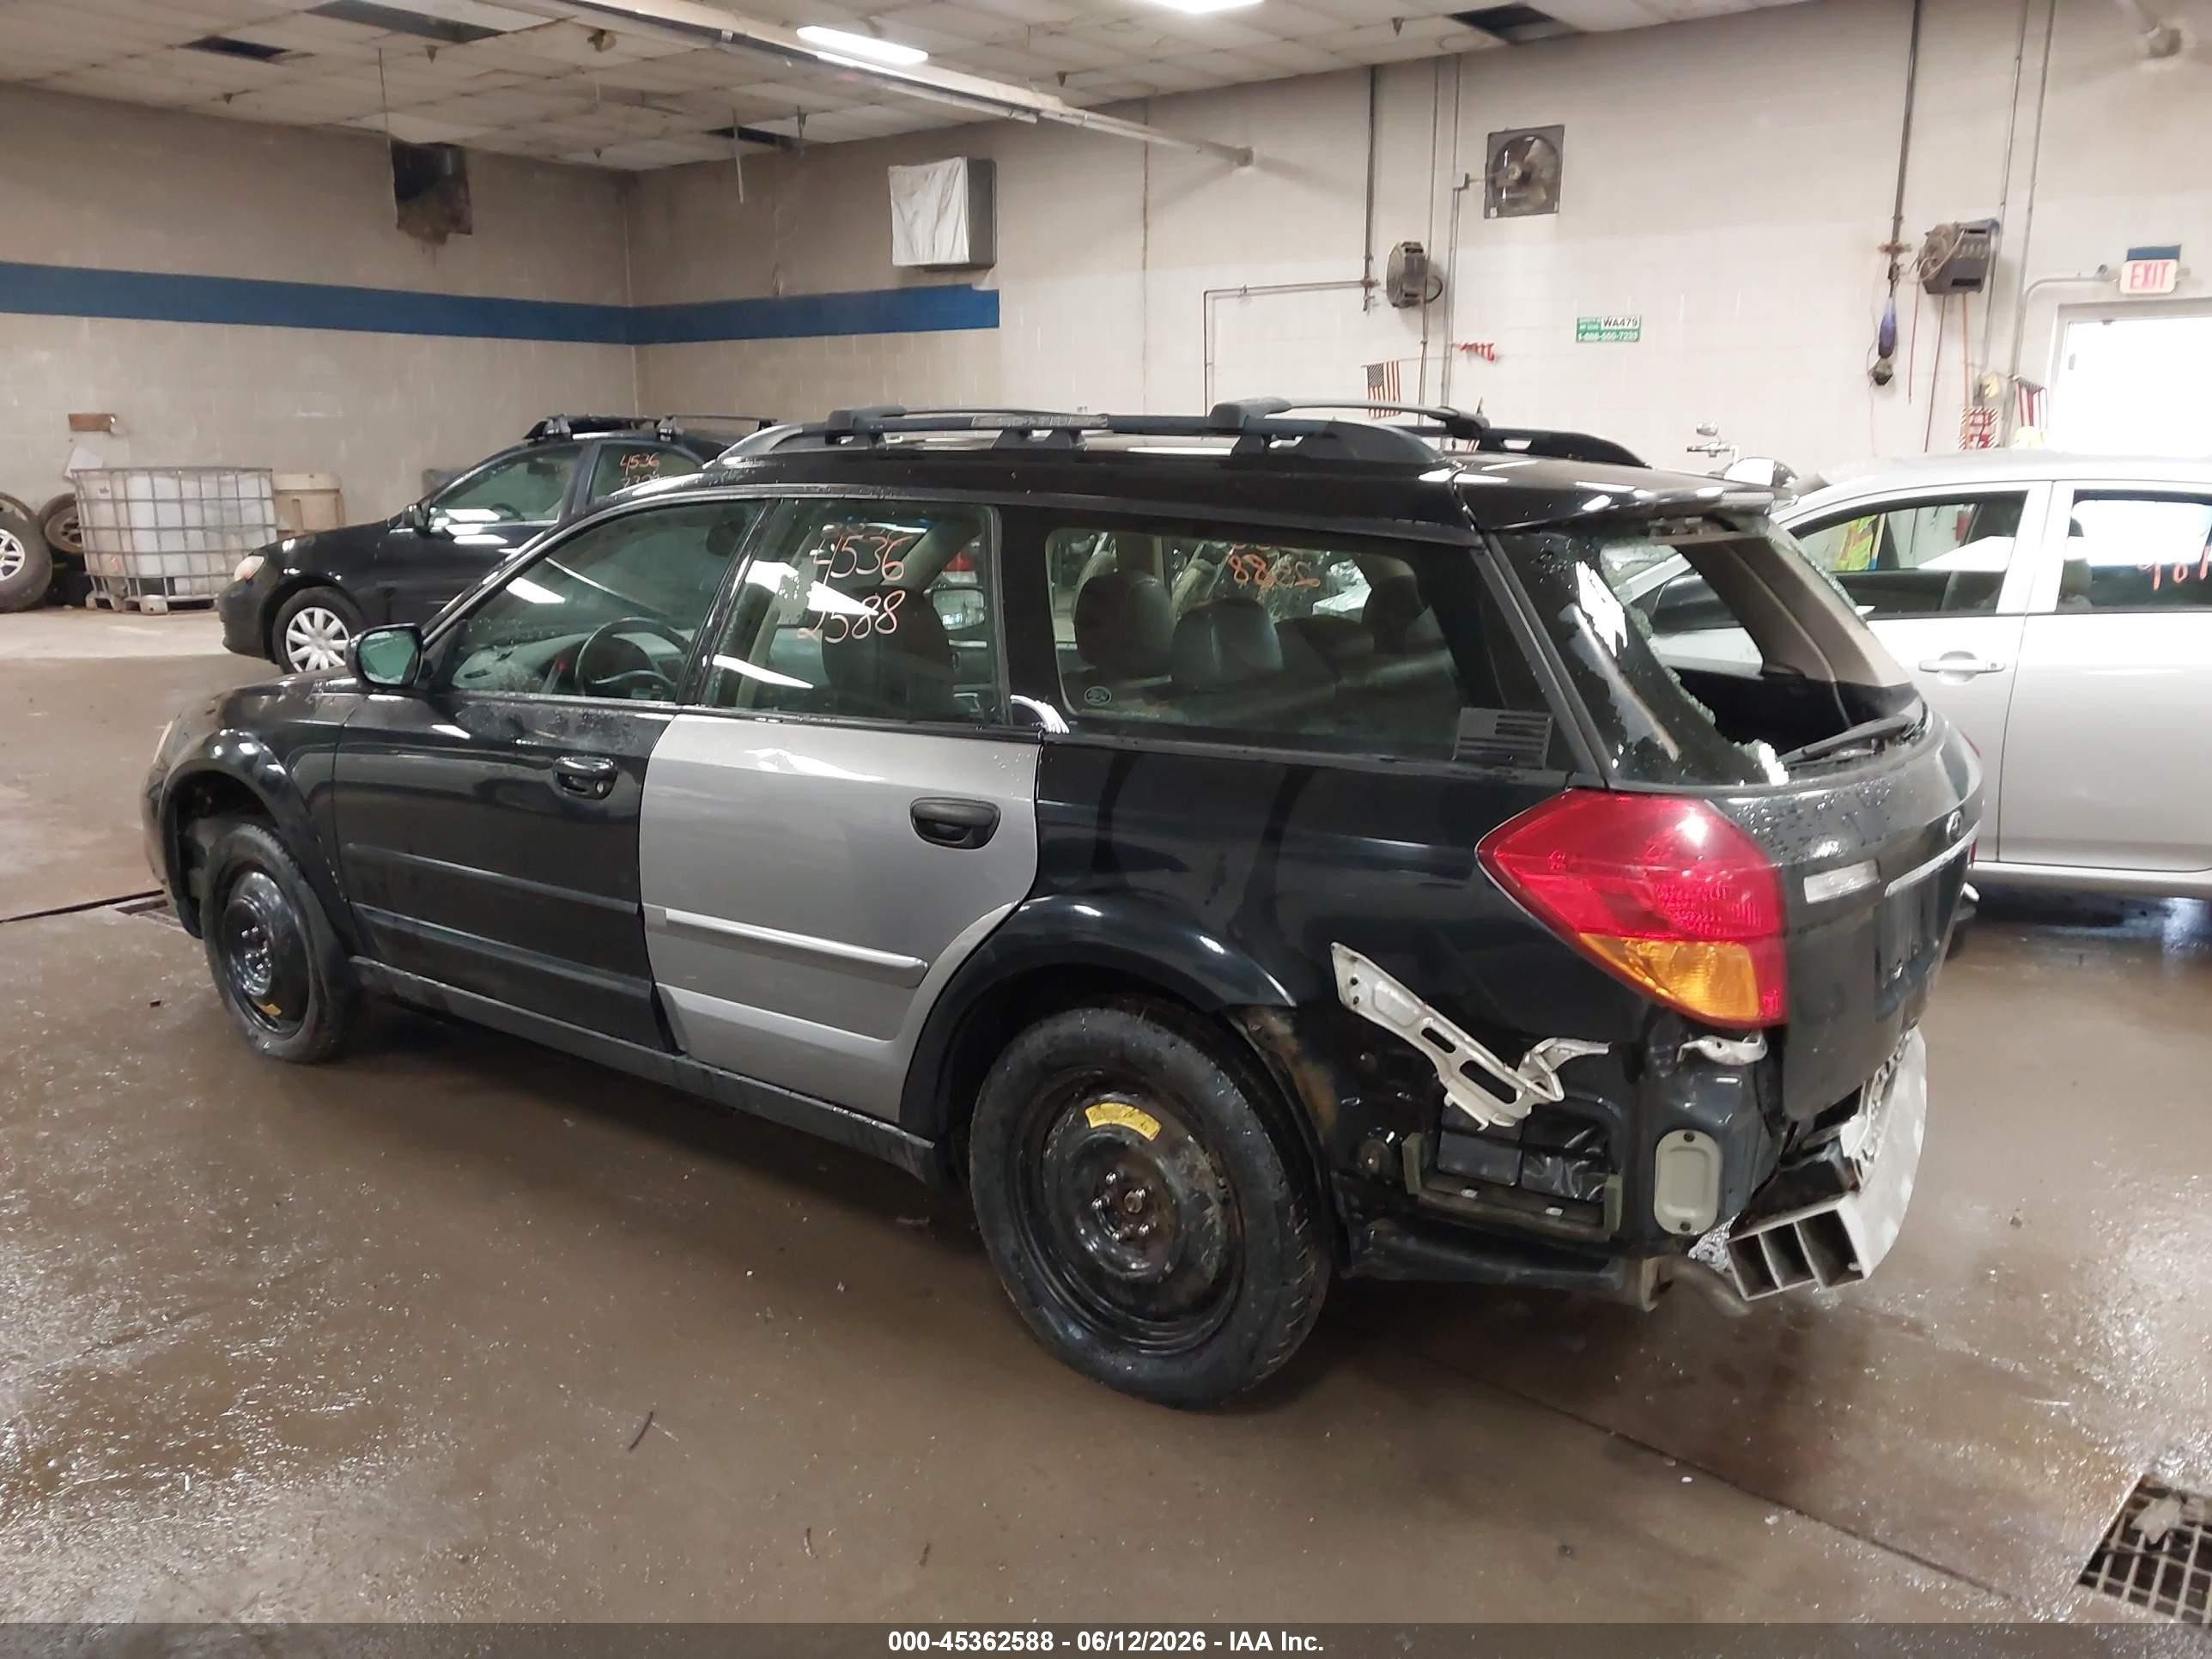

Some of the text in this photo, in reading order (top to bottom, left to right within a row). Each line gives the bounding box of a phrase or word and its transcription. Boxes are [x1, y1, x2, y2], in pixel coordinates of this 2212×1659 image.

[2130, 260, 2171, 289] EXIT
[1603, 318, 1638, 327] WA479
[620, 452, 659, 477] 4536
[812, 534, 914, 586] 4536
[797, 590, 906, 644] 2588
